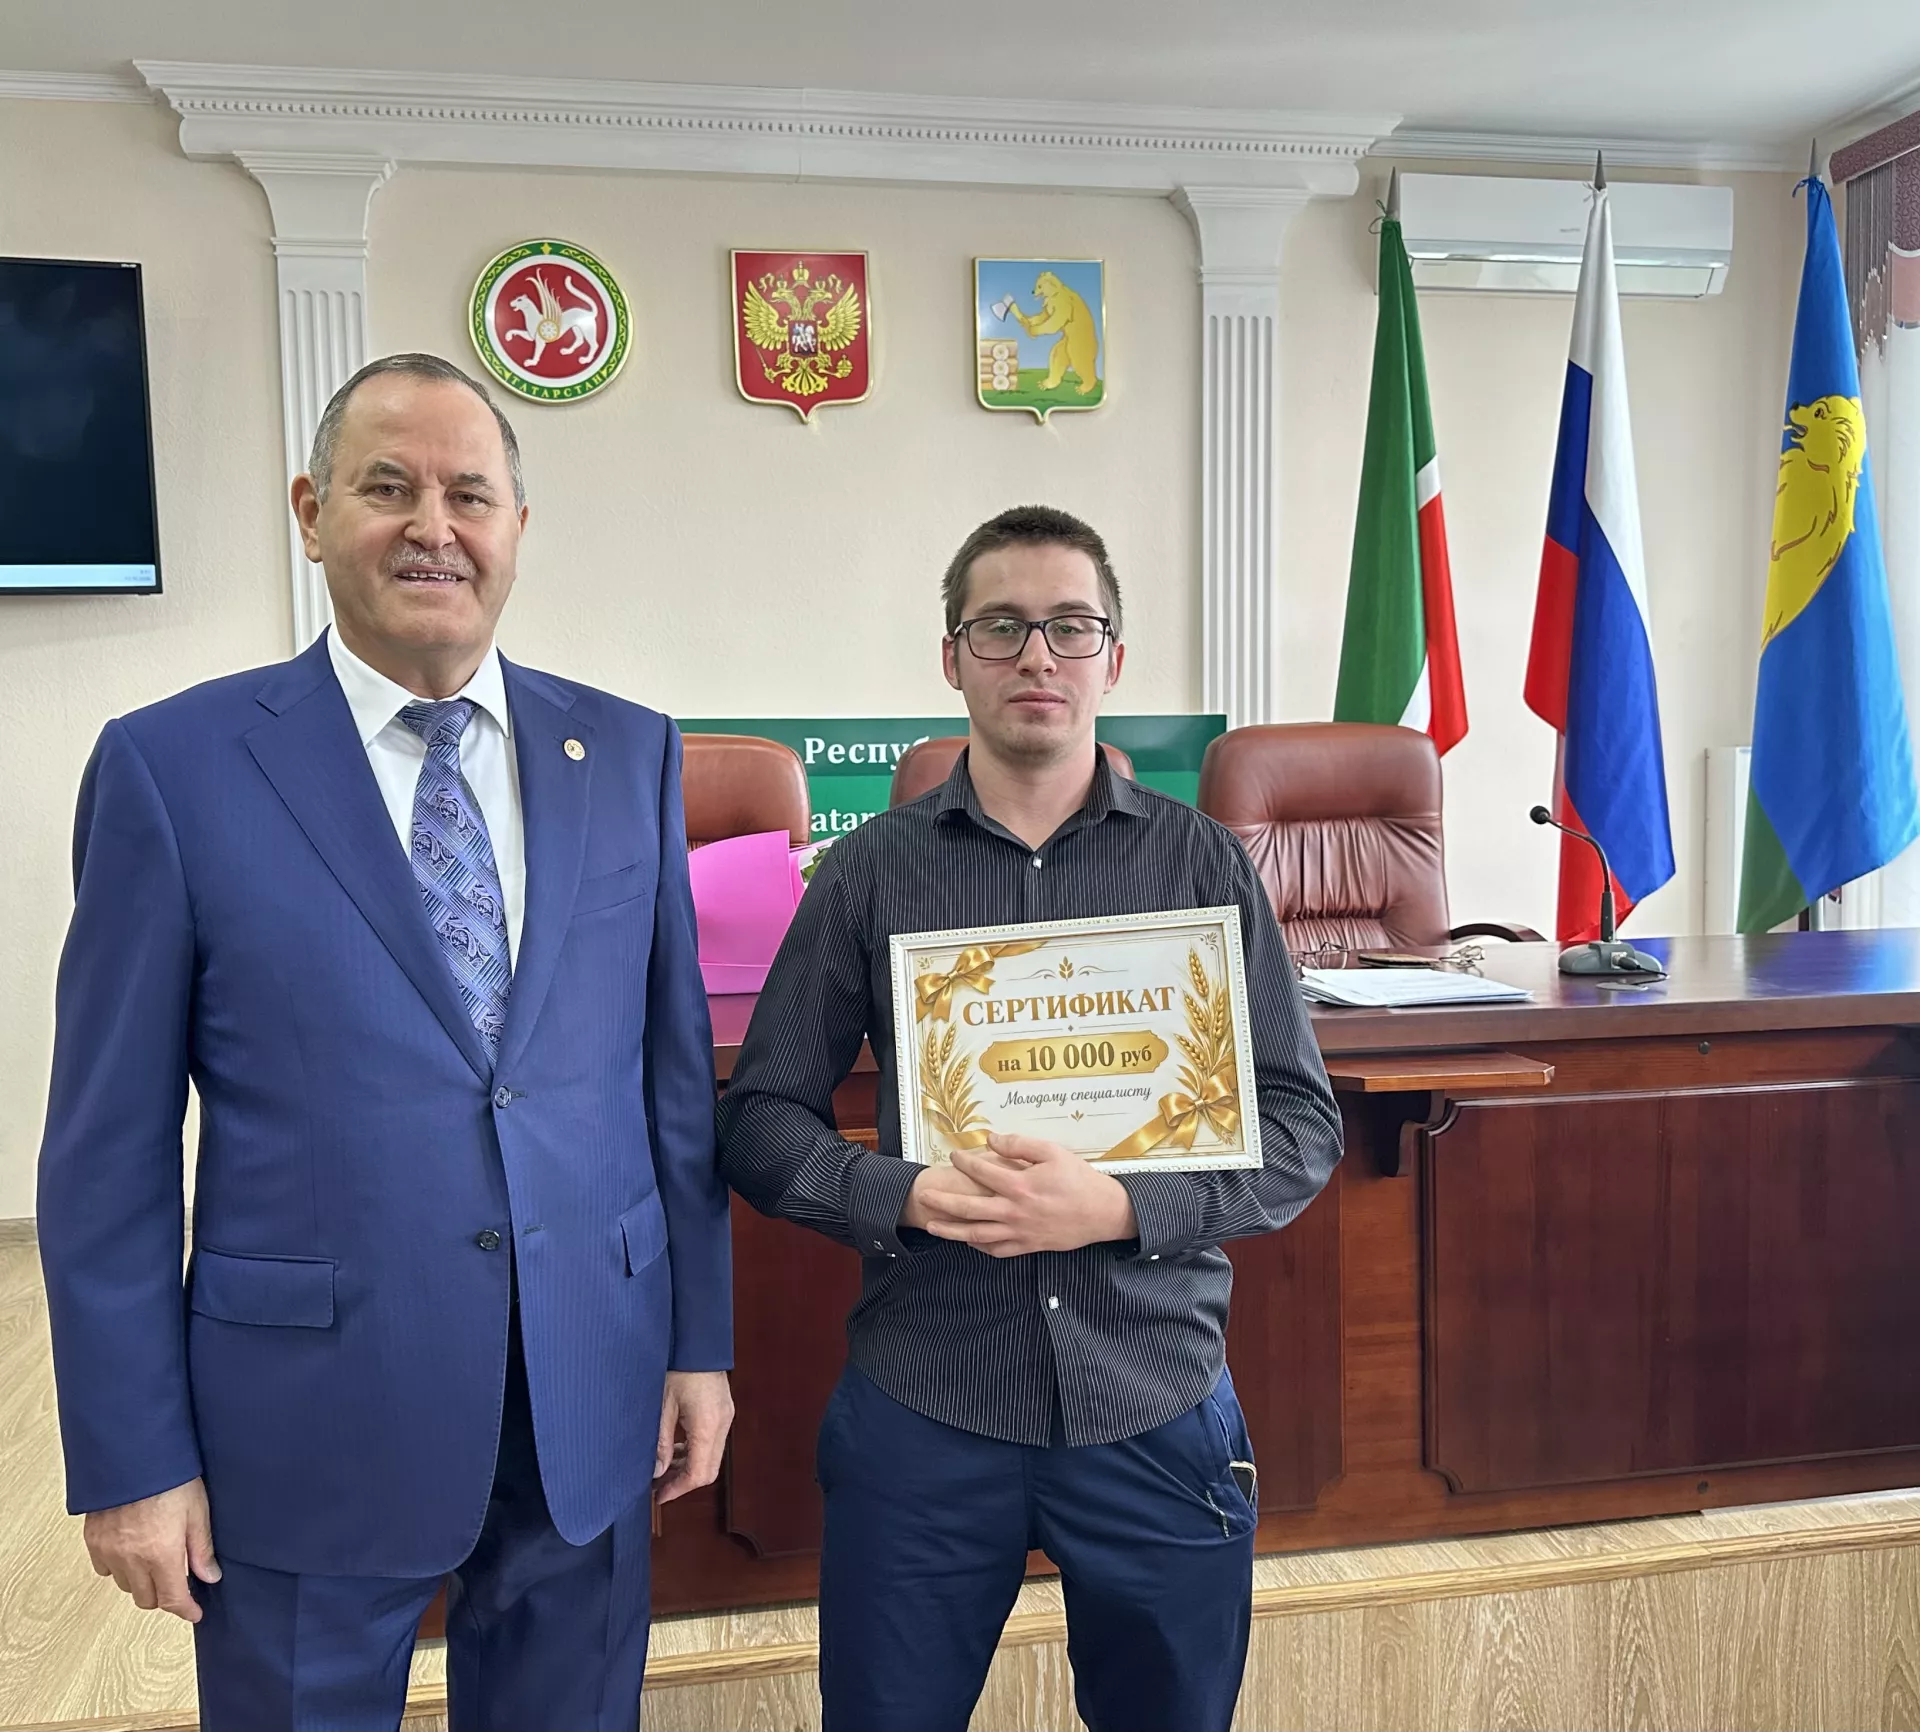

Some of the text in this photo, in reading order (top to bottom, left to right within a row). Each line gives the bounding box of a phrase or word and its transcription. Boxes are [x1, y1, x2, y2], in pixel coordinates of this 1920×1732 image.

[511, 375, 602, 398] ТАТАРСТАН
[962, 986, 1175, 1026] СЕРТИФИКАТ
[998, 1041, 1152, 1072] на 10 000 руб
[1000, 1086, 1152, 1109] Молодому специалисту
